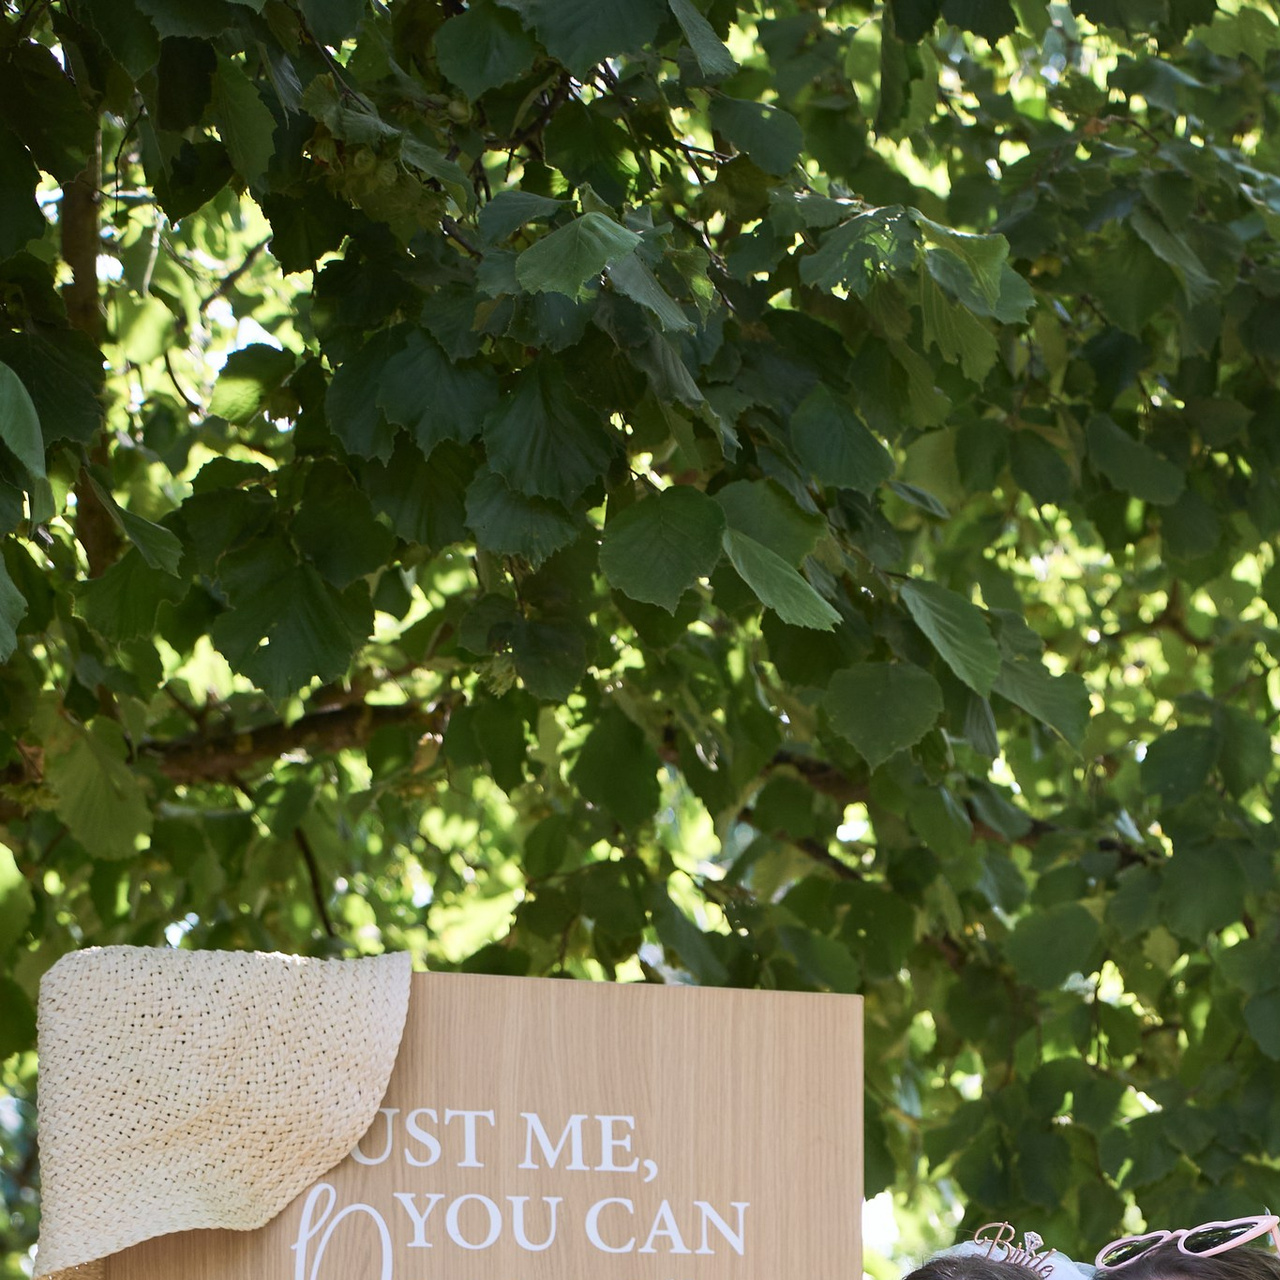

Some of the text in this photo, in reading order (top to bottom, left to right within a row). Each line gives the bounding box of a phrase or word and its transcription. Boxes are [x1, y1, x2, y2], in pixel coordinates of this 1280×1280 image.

[350, 1107, 659, 1183] UST ME,
[393, 1192, 751, 1256] YOU CAN
[974, 1221, 1056, 1280] Bride
